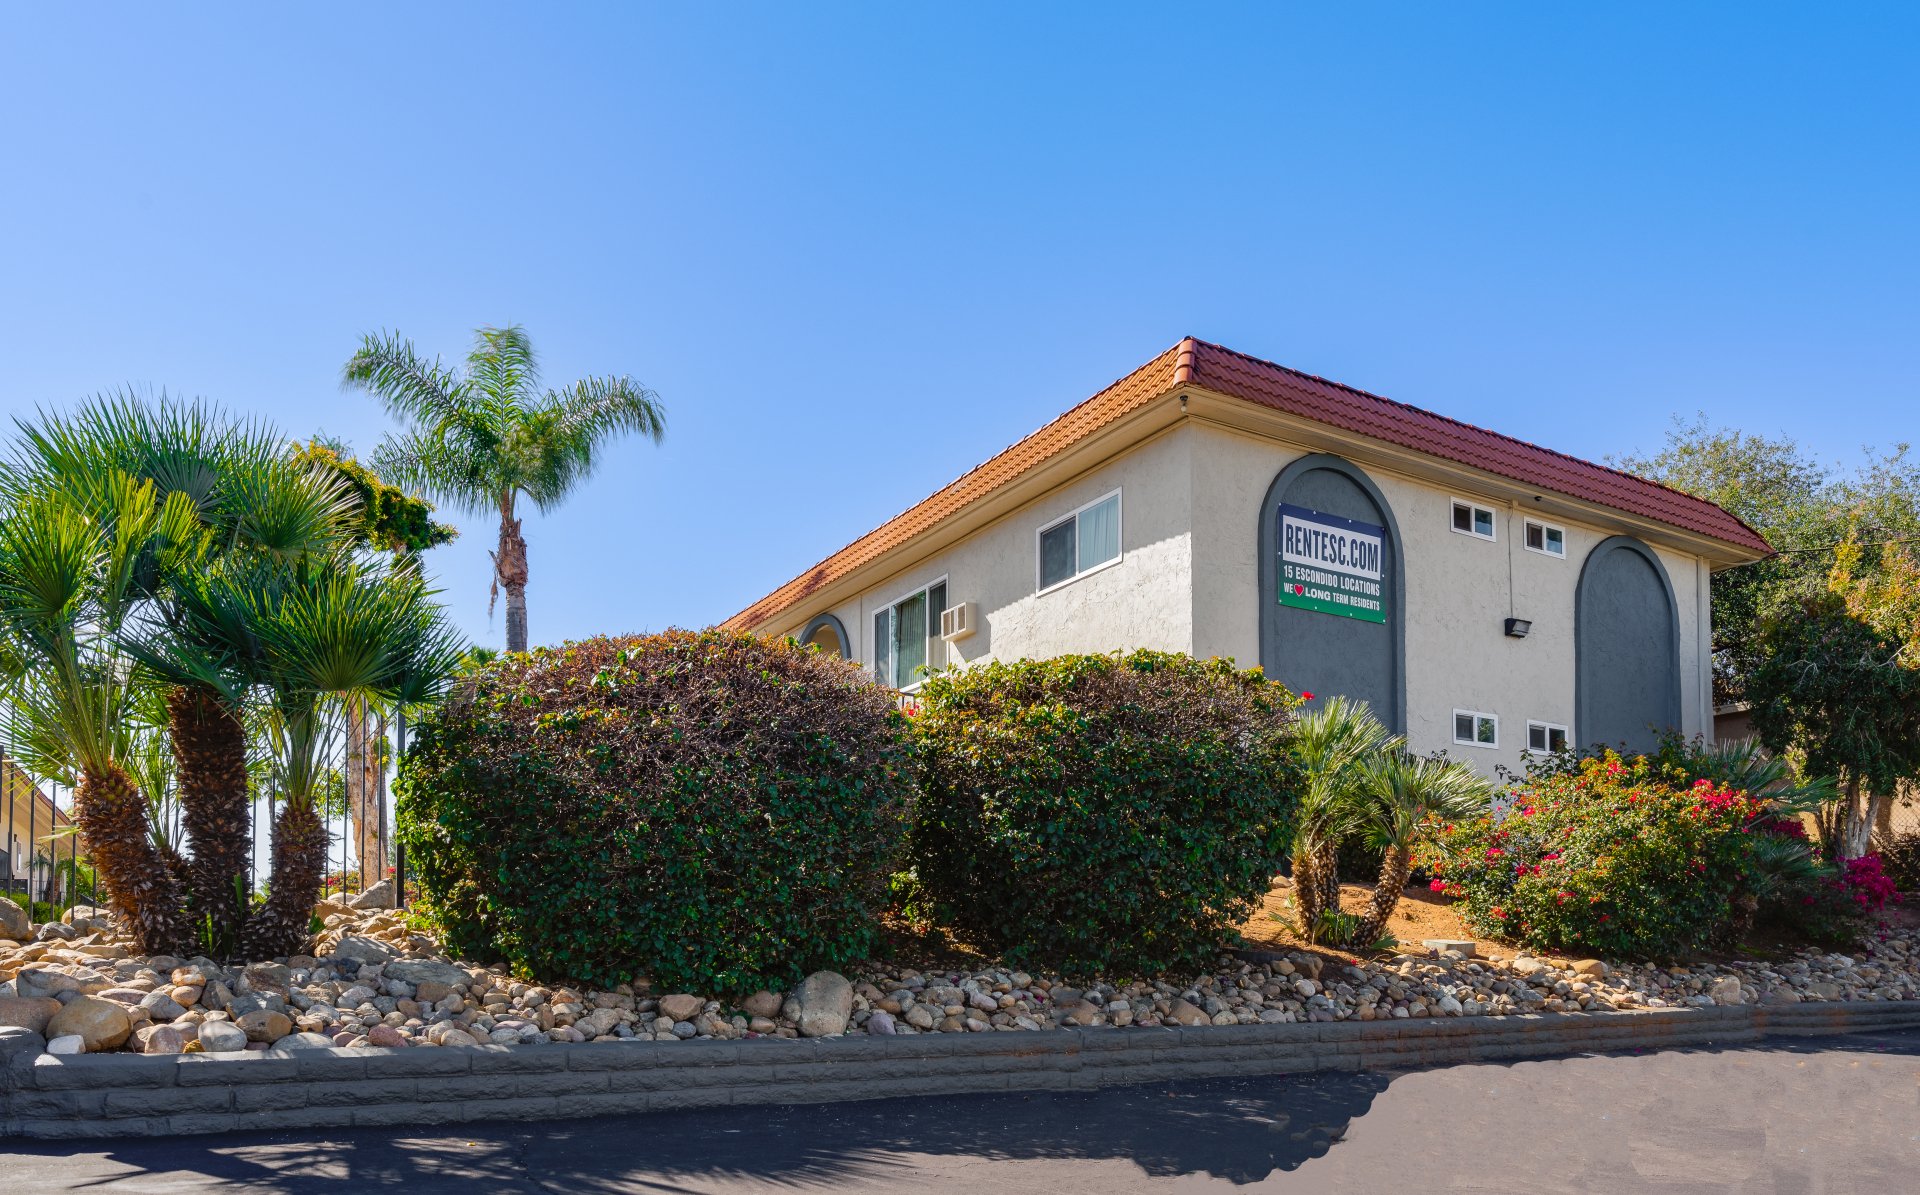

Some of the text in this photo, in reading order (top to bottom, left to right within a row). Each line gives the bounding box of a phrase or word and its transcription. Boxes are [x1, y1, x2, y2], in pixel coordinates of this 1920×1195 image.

[1285, 523, 1379, 573] RENTESC.COM
[1283, 565, 1380, 597] 15 ESCONDIDO LOCATIONS
[1283, 582, 1380, 611] WE LONG TERM RESIDENTS
